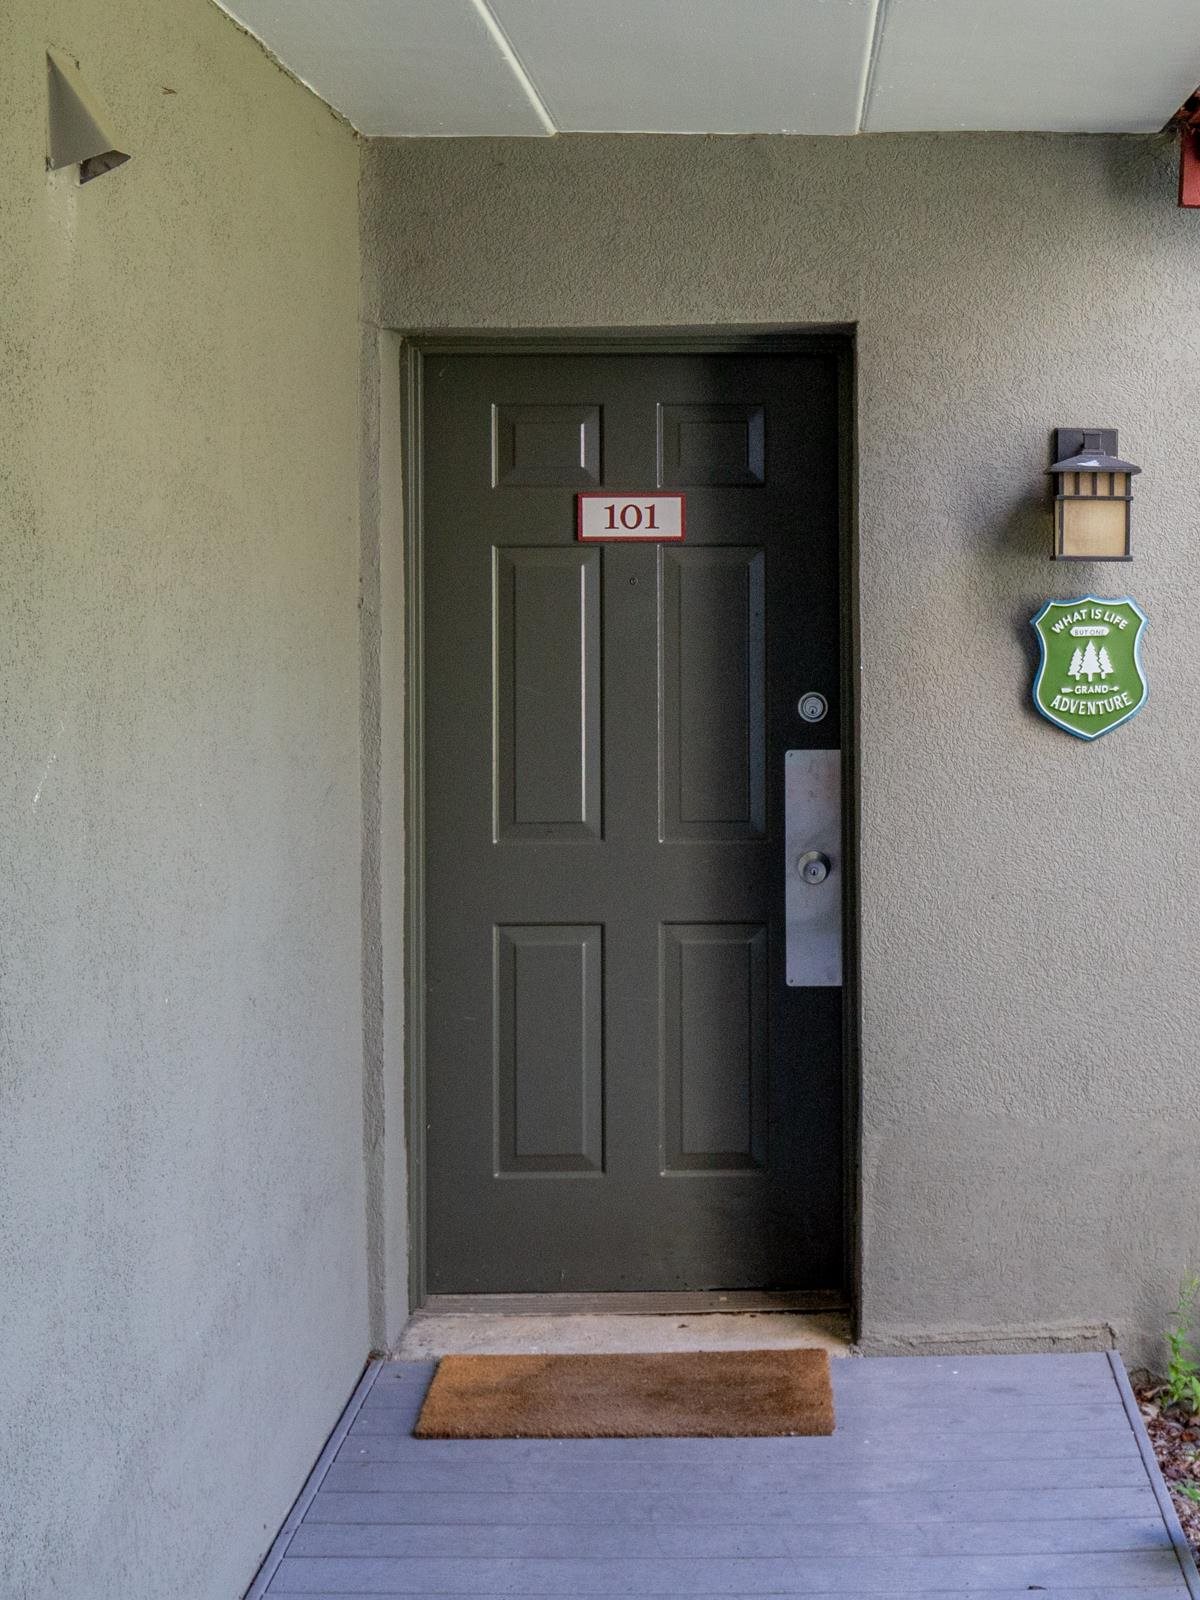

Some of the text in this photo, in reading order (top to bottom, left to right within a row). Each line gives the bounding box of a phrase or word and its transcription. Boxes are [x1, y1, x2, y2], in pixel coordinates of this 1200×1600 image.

[604, 504, 659, 529] 101
[1051, 608, 1128, 634] WHAT IS LIFE
[1074, 685, 1109, 694] GRAND
[1050, 692, 1133, 715] ADVENTURE
